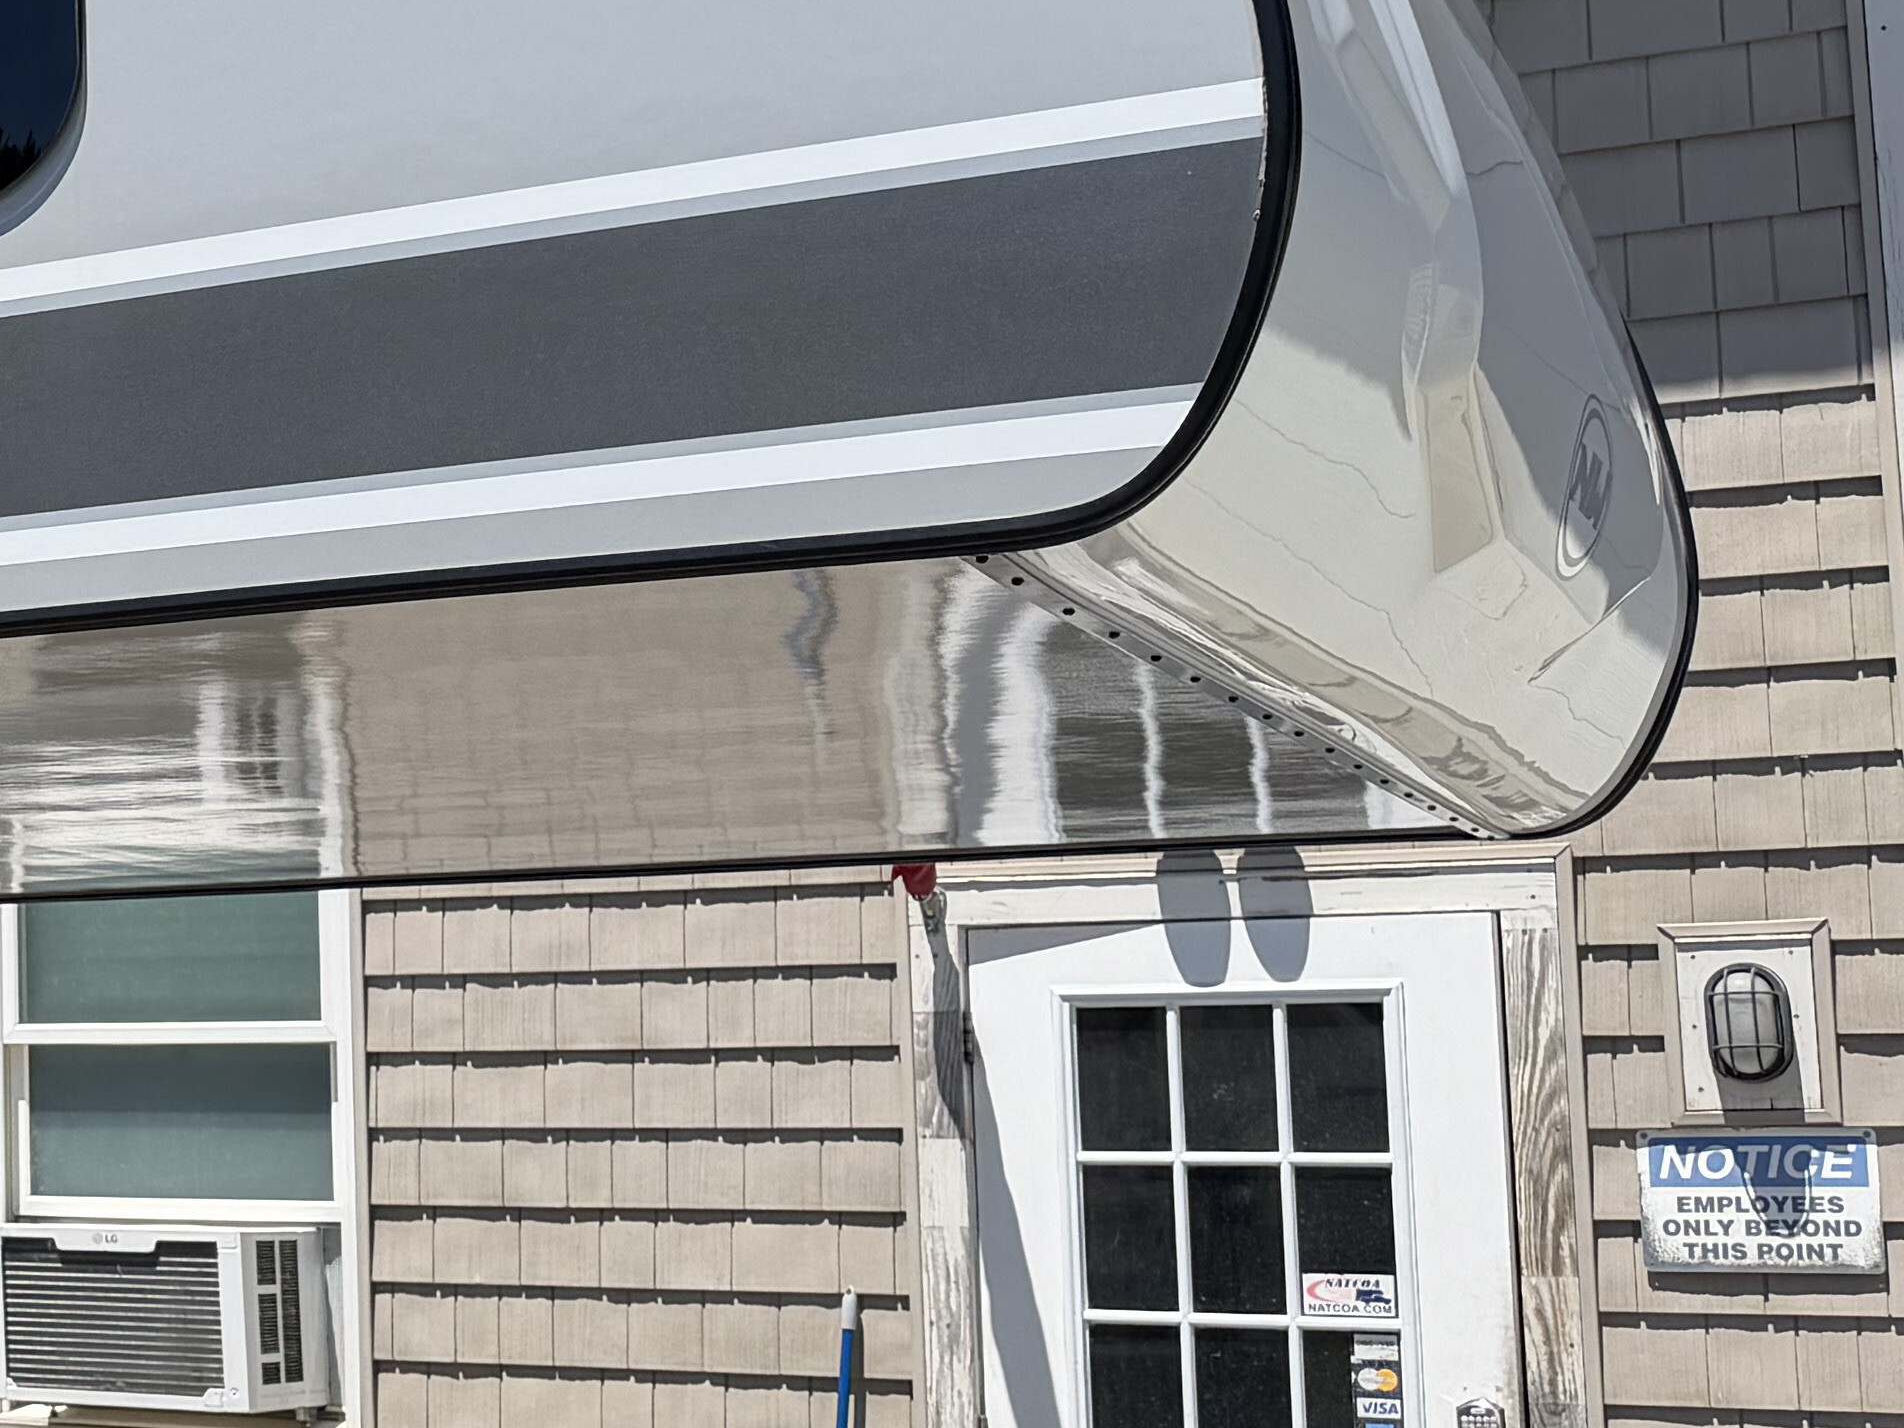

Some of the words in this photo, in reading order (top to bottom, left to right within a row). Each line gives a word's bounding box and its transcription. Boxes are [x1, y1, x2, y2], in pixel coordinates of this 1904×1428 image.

[1659, 1143, 1857, 1179] NOTICE
[1676, 1195, 1845, 1214] EMPLOYEES
[1662, 1219, 1733, 1237] ONLY
[1744, 1219, 1863, 1238] BEYOND
[1682, 1243, 1748, 1261] THIS
[1757, 1243, 1844, 1261] POINT
[1325, 1278, 1380, 1289] NATCOA
[1308, 1303, 1392, 1314] NATCOACOM
[1362, 1402, 1399, 1415] VISA
